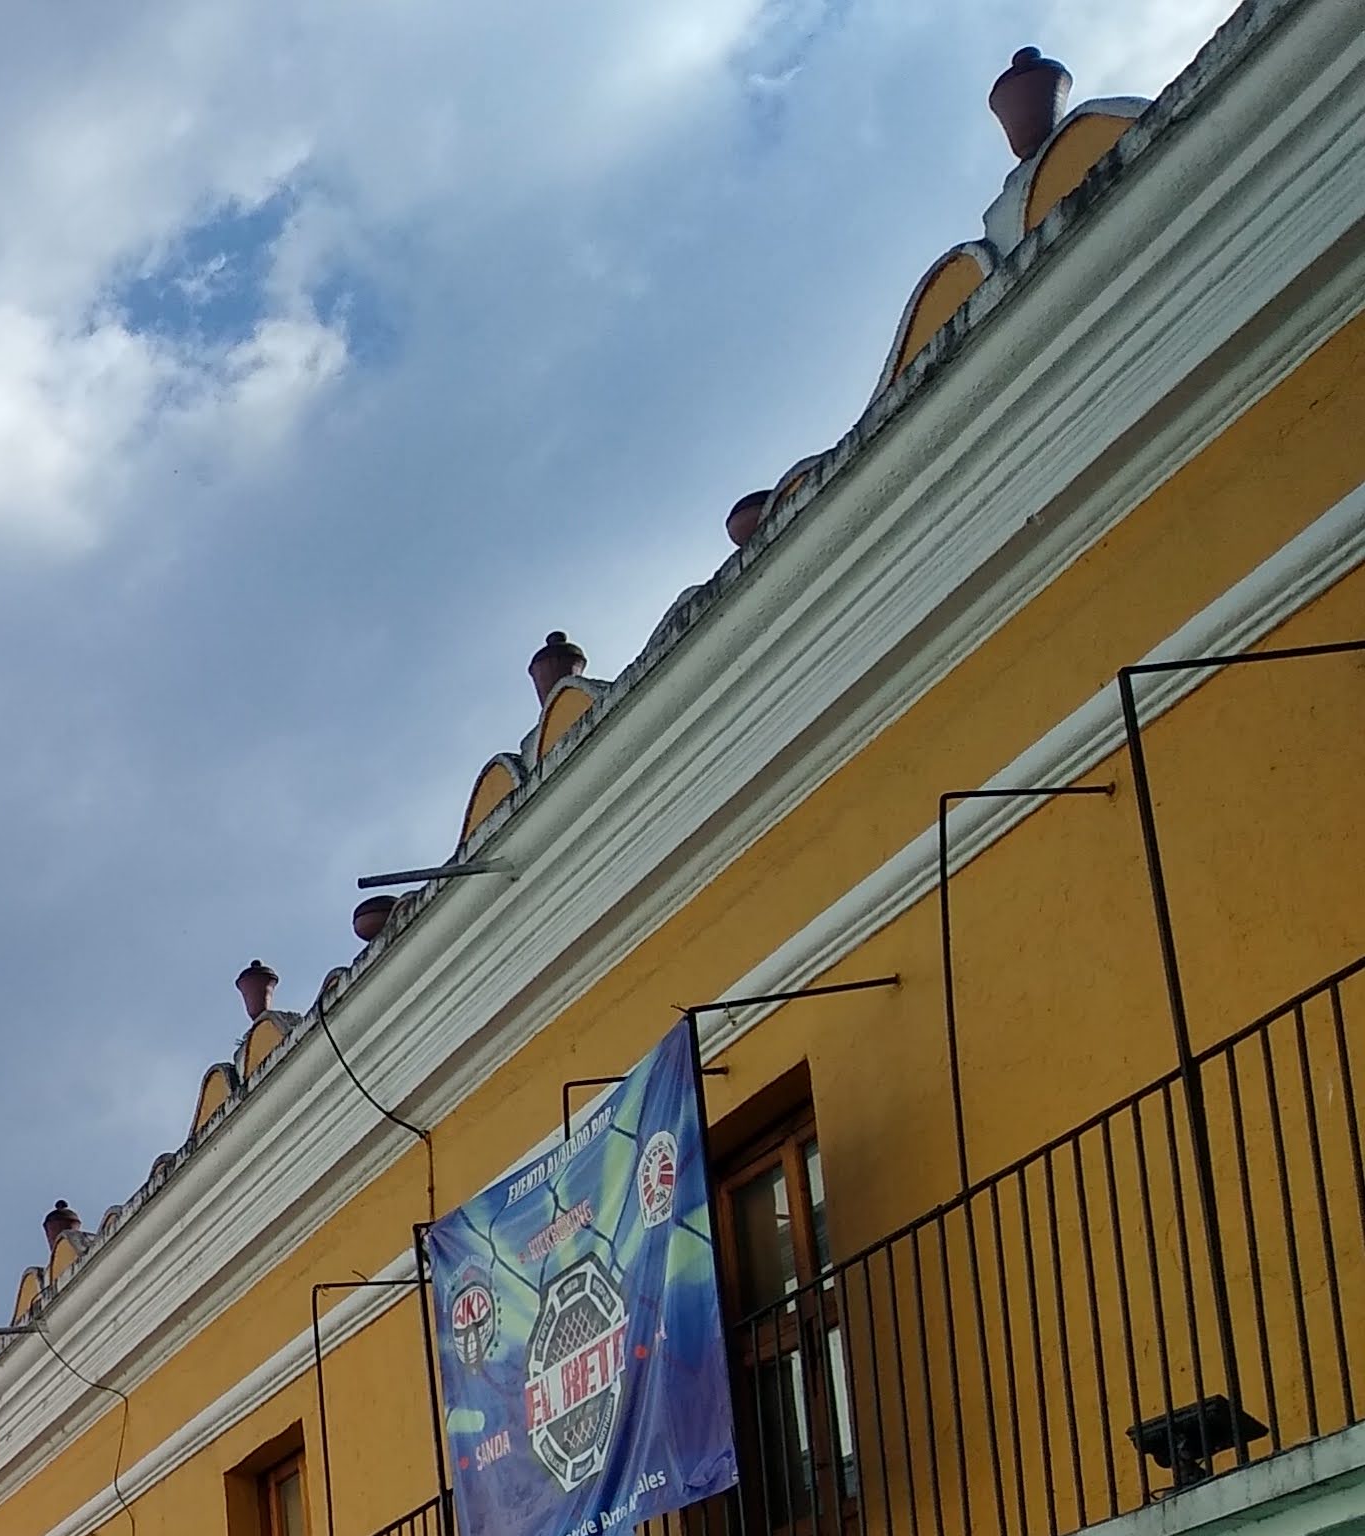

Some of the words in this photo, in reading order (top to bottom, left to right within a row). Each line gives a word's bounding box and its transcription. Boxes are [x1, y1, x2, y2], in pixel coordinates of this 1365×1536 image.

[506, 1161, 546, 1203] EVENTO
[527, 1199, 594, 1260] KICKBOXING
[454, 1291, 489, 1325] WKA
[526, 1379, 557, 1430] EL
[476, 1430, 510, 1471] SANDA
